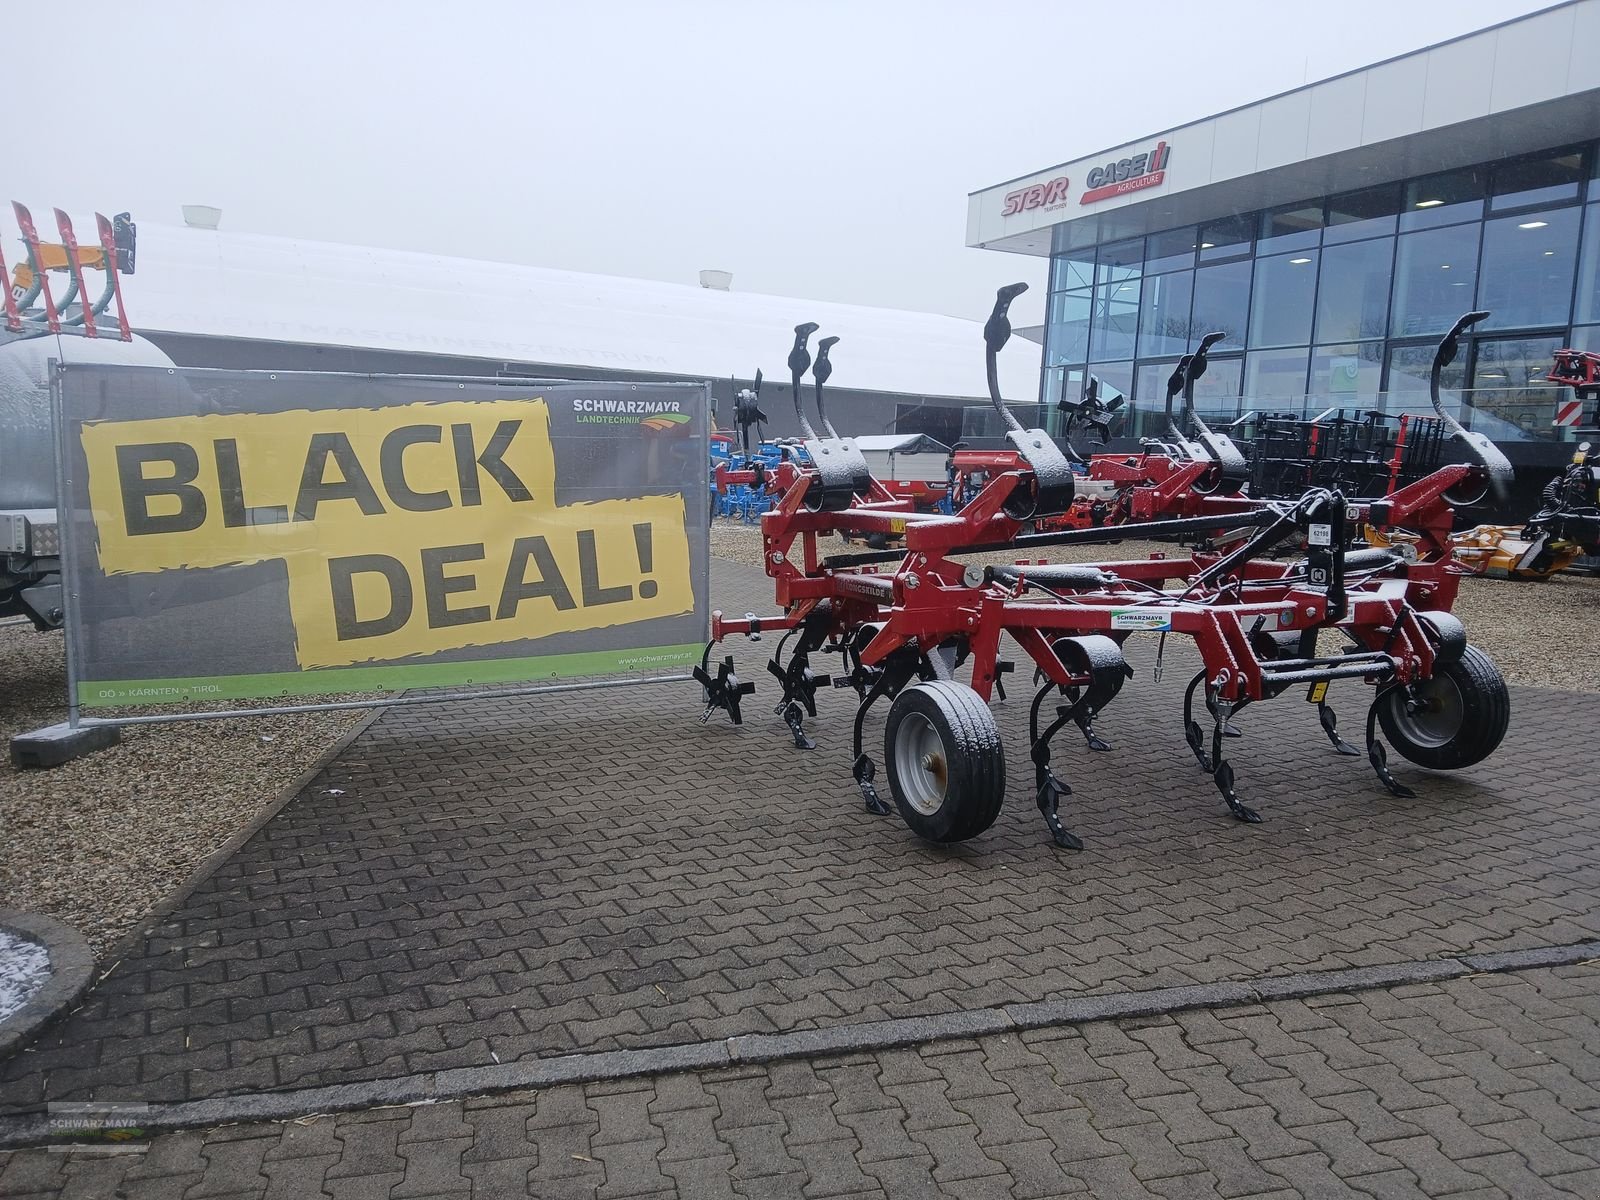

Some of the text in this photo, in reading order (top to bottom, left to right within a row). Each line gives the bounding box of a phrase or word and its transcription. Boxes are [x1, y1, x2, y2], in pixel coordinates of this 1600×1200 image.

[1086, 152, 1148, 189] CASE
[1116, 174, 1160, 193] AGRICULTURE
[1001, 176, 1069, 216] STEYR
[573, 399, 680, 413] SCHWARZMAYR
[576, 415, 640, 424] LANDTECHNIK
[115, 419, 534, 537] BLACK
[327, 522, 659, 642] DEAL!
[617, 652, 693, 665] www.schwarzmayr.at
[99, 690, 115, 698] OÖ
[128, 687, 179, 697] KÄRNTEN
[192, 685, 222, 693] TIROL
